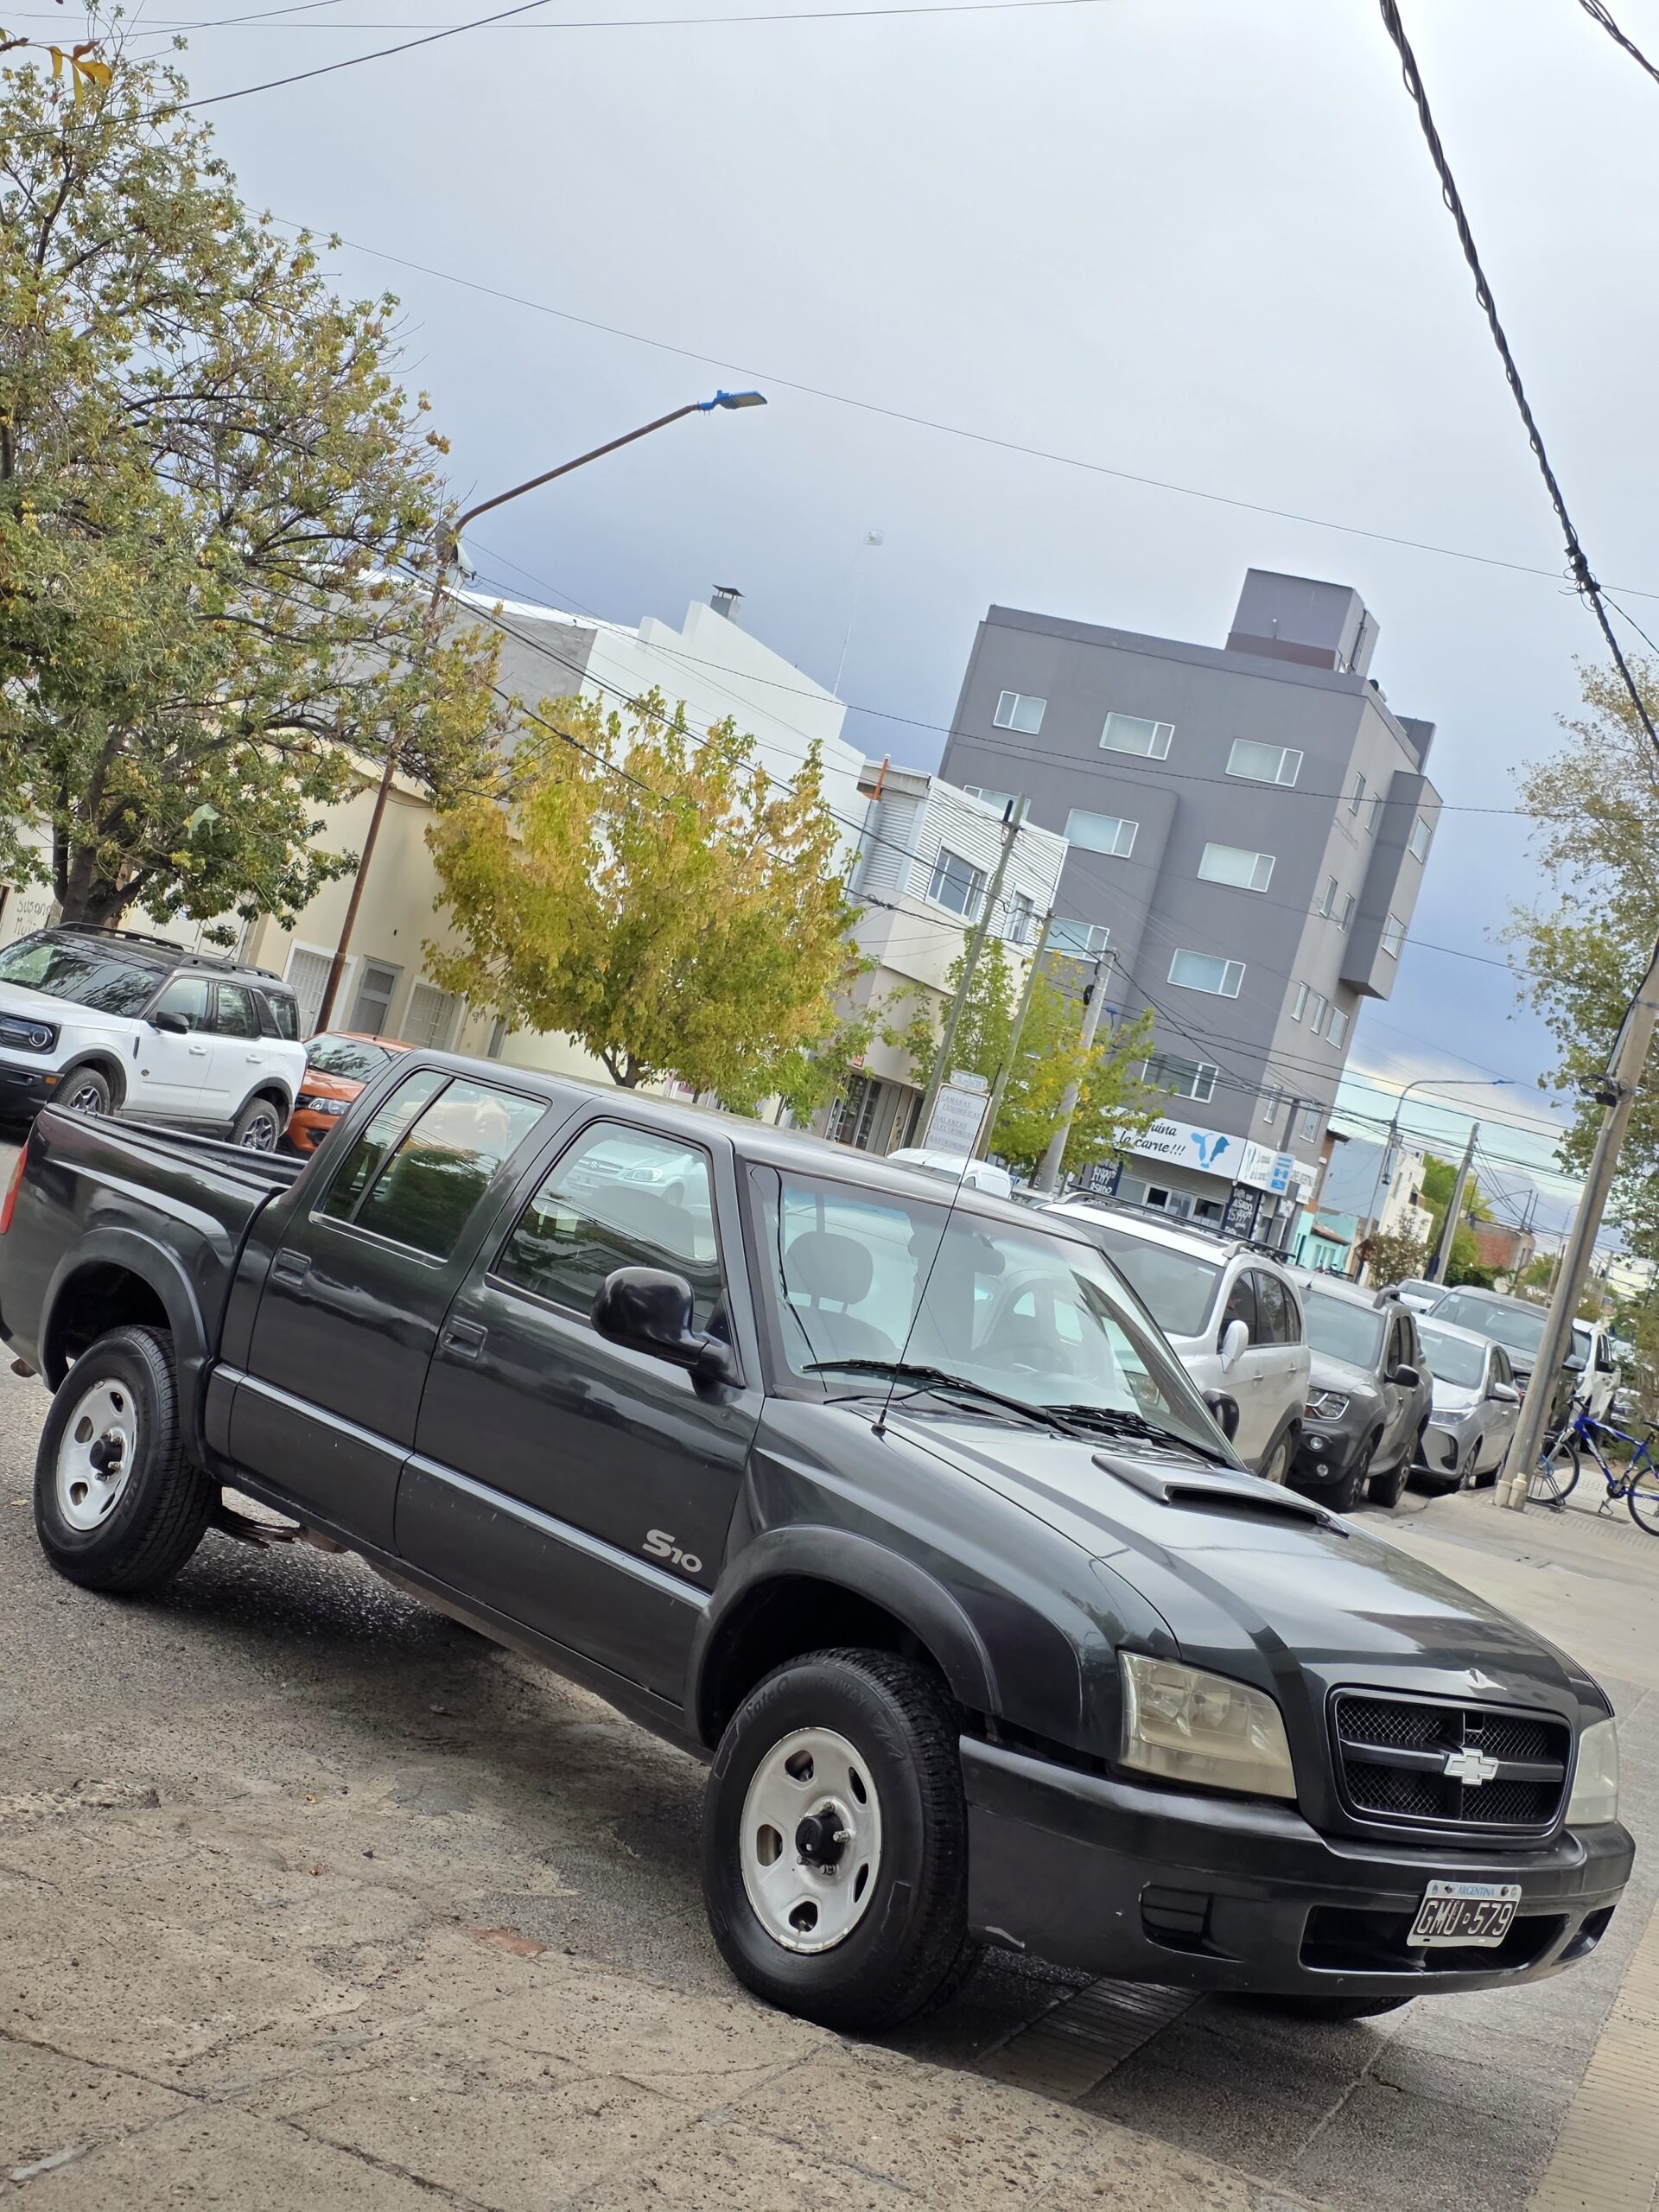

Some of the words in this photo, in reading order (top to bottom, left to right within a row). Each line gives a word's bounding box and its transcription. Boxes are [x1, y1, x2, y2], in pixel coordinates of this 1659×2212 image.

[642, 1529, 702, 1573] S10
[1458, 1885, 1496, 1897] ARGENTINA
[1416, 1900, 1465, 1935] GMU
[1467, 1902, 1513, 1936] 579
